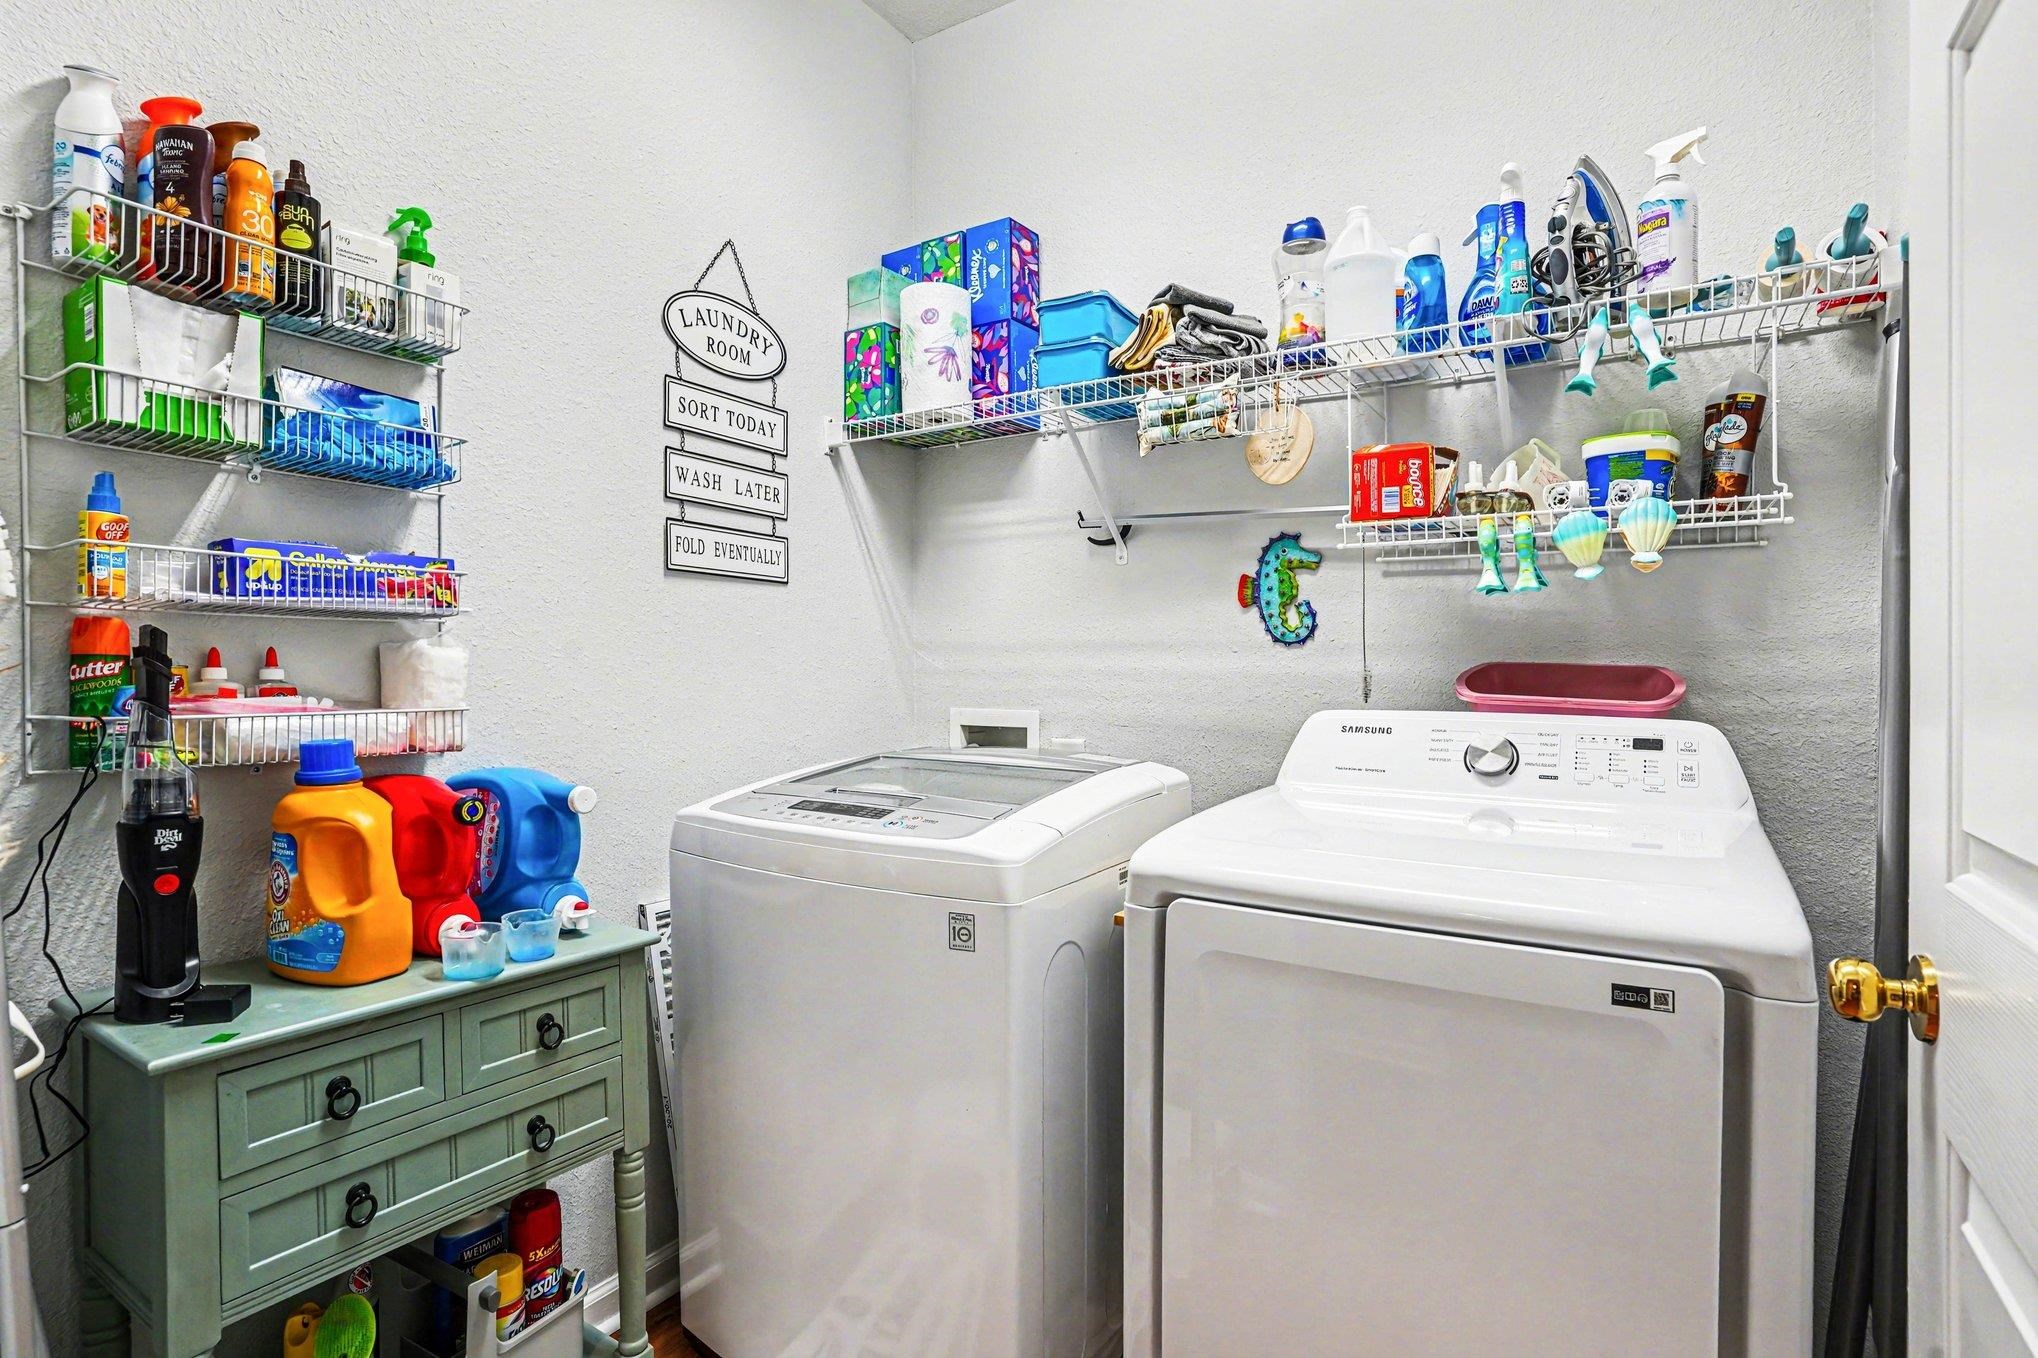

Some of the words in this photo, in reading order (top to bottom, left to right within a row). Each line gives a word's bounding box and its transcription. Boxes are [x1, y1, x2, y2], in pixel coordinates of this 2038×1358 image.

[155, 138, 193, 151] HAWAIIAN
[165, 182, 175, 194] 4
[241, 209, 274, 239] 30
[282, 211, 315, 232] BUM
[283, 204, 309, 225] SUN
[335, 234, 351, 246] ring
[428, 273, 446, 286] ring
[968, 248, 984, 303] Kleenex
[678, 306, 774, 357] LAUNDRY
[706, 336, 752, 366] ROOM
[678, 396, 720, 424] SORT
[726, 410, 777, 438] TODAY
[675, 465, 722, 491] WASH
[735, 478, 780, 503] LATER
[1408, 458, 1425, 508] bounce
[100, 522, 130, 532] GOOF
[105, 531, 124, 540] OFF
[675, 535, 705, 556] FOLD
[714, 540, 781, 566] EVENTUALLY
[69, 660, 124, 681] Cutter
[1341, 725, 1393, 735] SAMSUNG
[463, 1234, 503, 1260] WEIMAN
[528, 1247, 545, 1262] 5X
